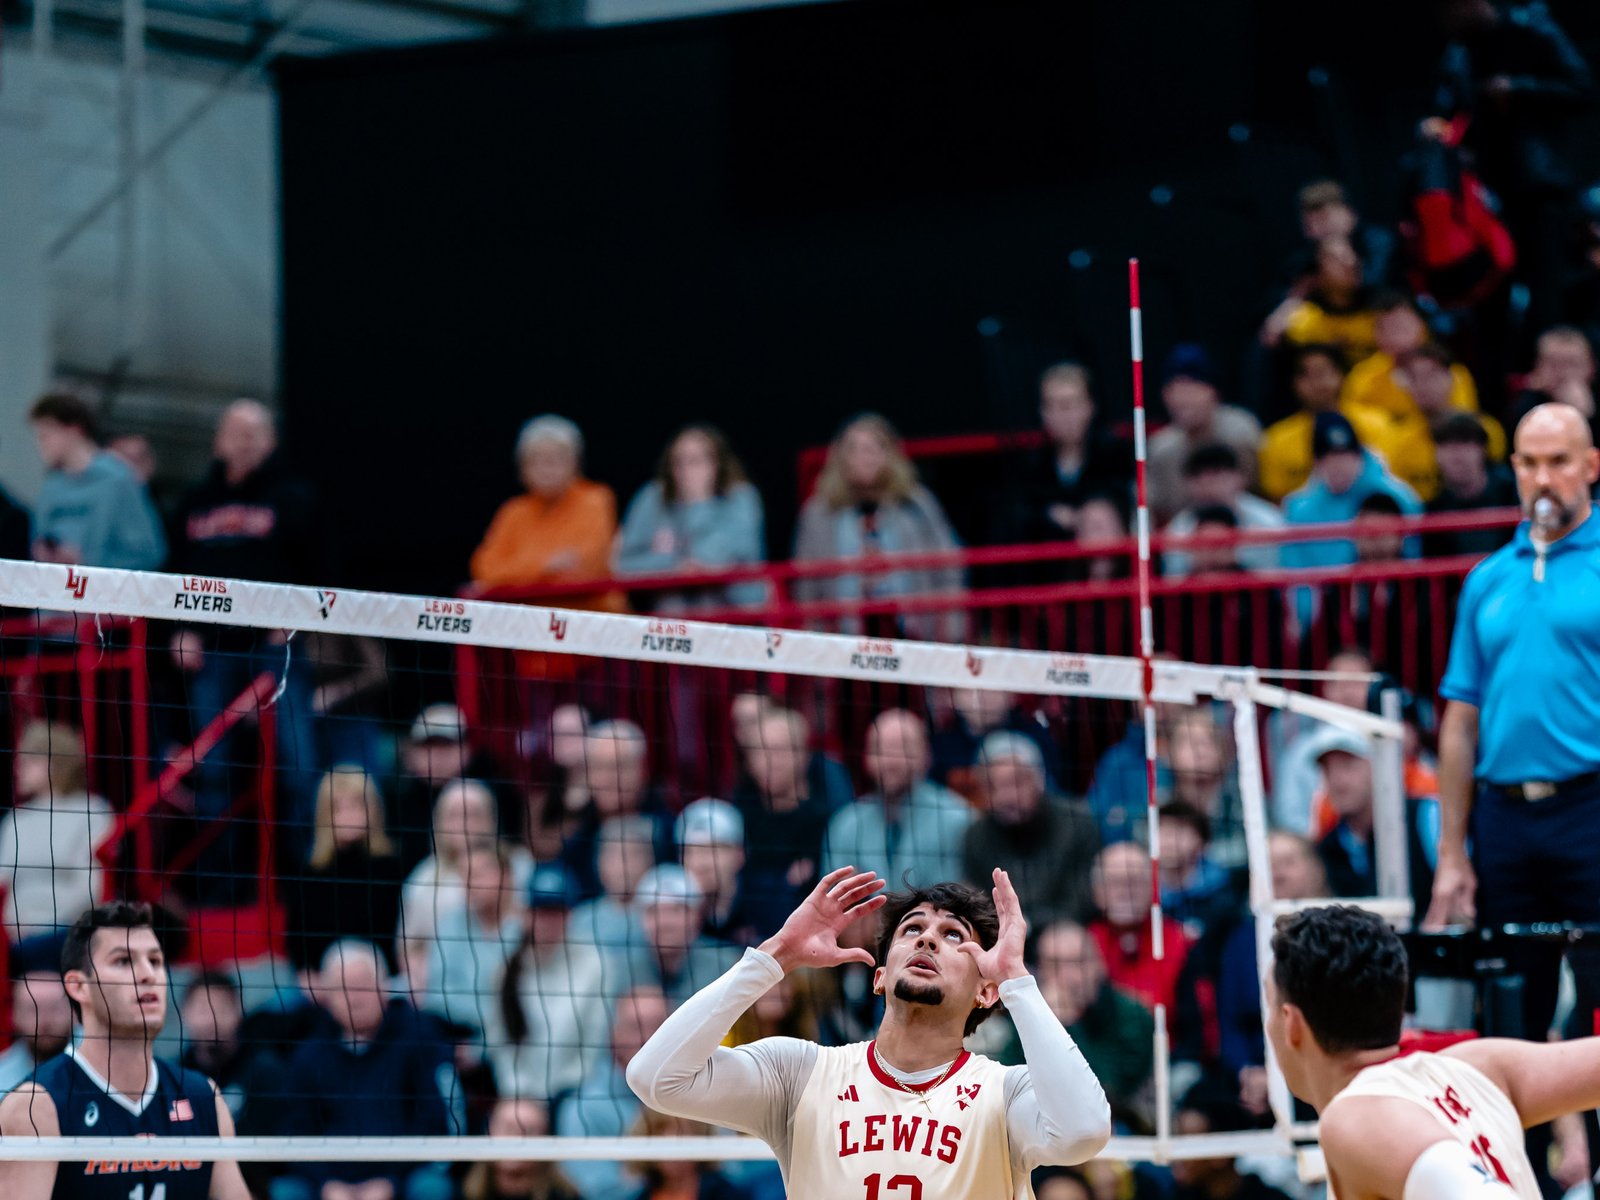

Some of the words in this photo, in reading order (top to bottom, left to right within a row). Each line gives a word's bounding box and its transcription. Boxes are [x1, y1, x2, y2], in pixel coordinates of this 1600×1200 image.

[183, 577, 227, 594] LEWIS
[174, 593, 232, 613] FLYERS
[424, 599, 465, 616] LEWIS
[417, 614, 472, 634] FLYERS
[641, 634, 692, 654] FLYERS
[838, 1114, 962, 1164] LEWIS
